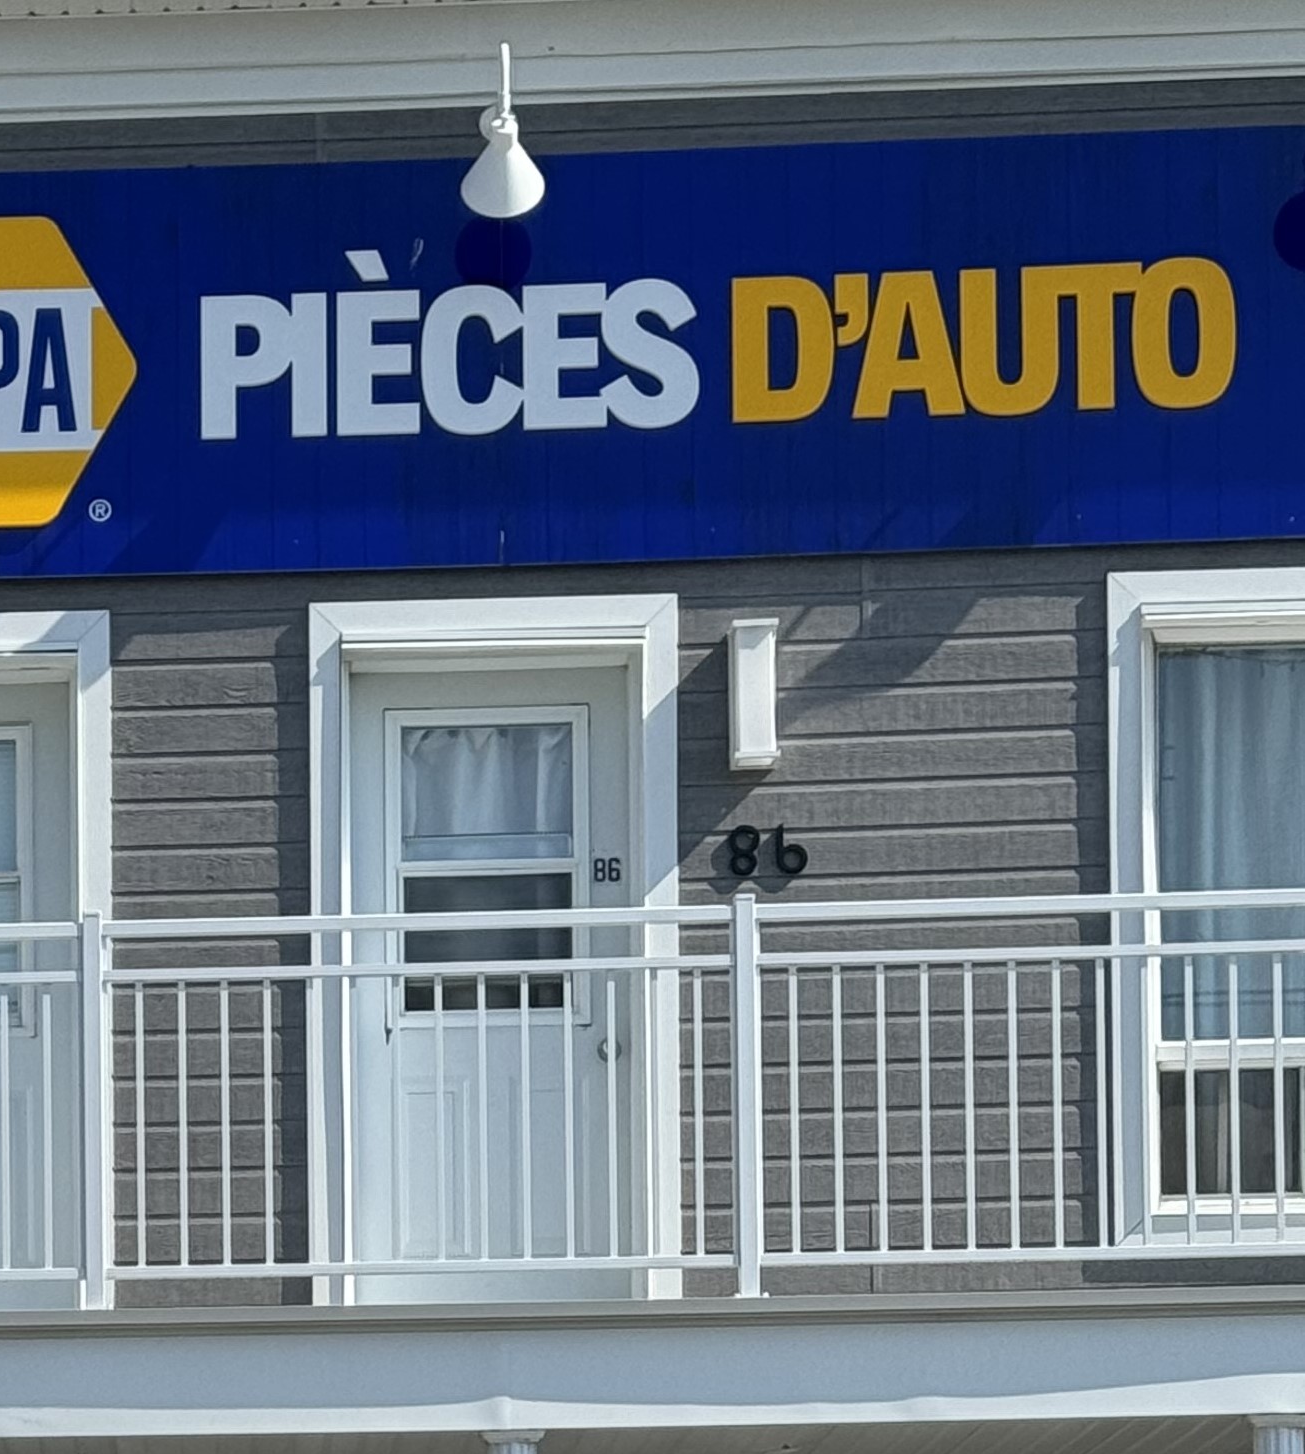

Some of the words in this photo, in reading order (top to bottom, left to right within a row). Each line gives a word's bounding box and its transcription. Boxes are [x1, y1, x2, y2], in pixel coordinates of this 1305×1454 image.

[201, 250, 700, 440] PIÈCES
[732, 257, 1236, 424] D'AUTO
[595, 857, 621, 882] 86
[729, 823, 808, 876] 86
